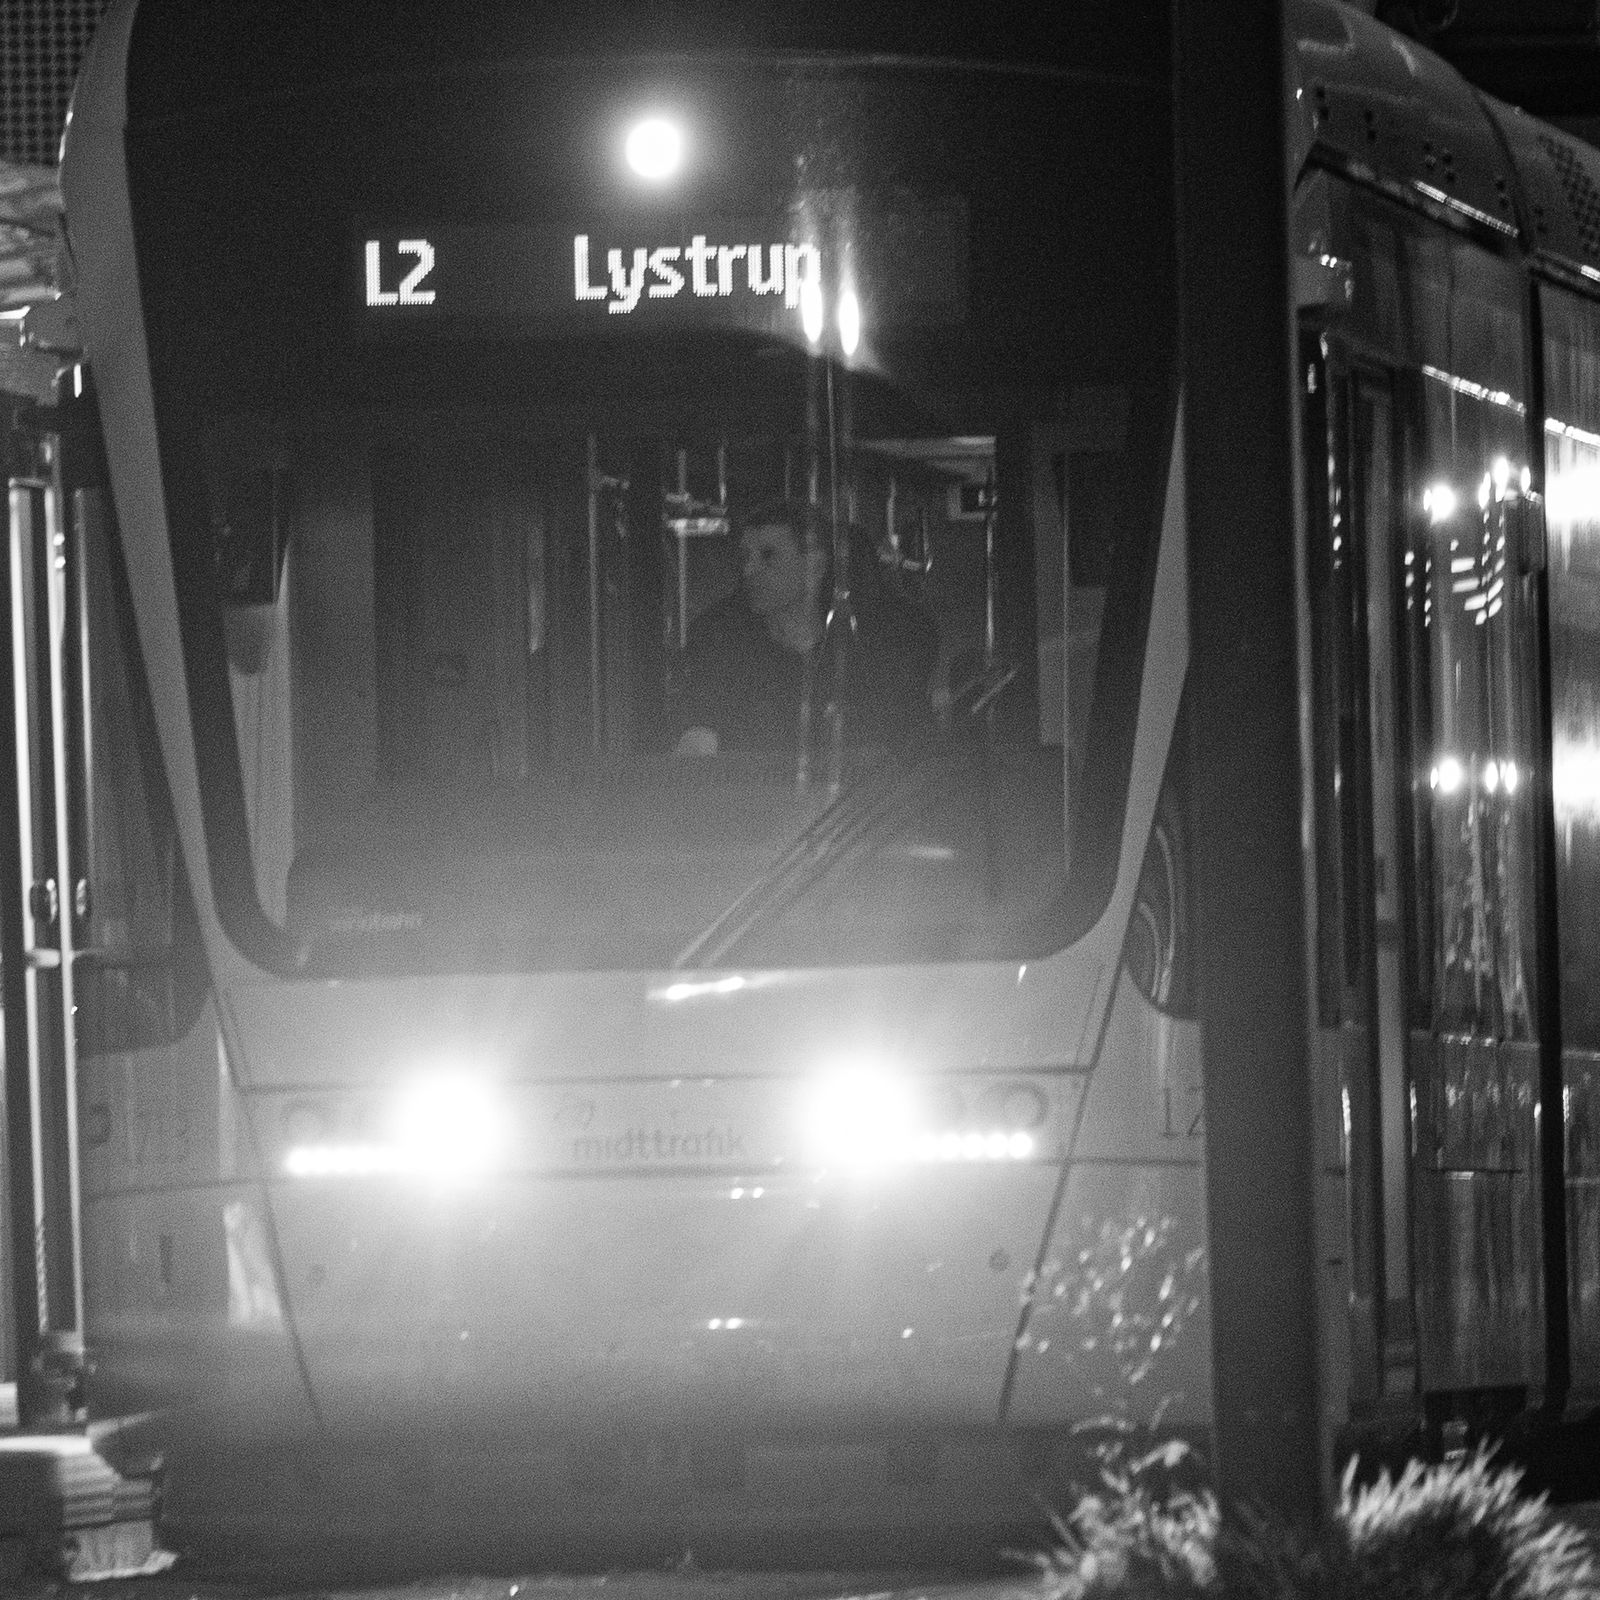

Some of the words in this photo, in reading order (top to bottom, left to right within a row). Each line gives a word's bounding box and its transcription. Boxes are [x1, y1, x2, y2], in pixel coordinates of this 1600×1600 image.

[365, 239, 436, 307] L2
[574, 235, 820, 314] Lystrup
[571, 1127, 748, 1161] midttrafik
